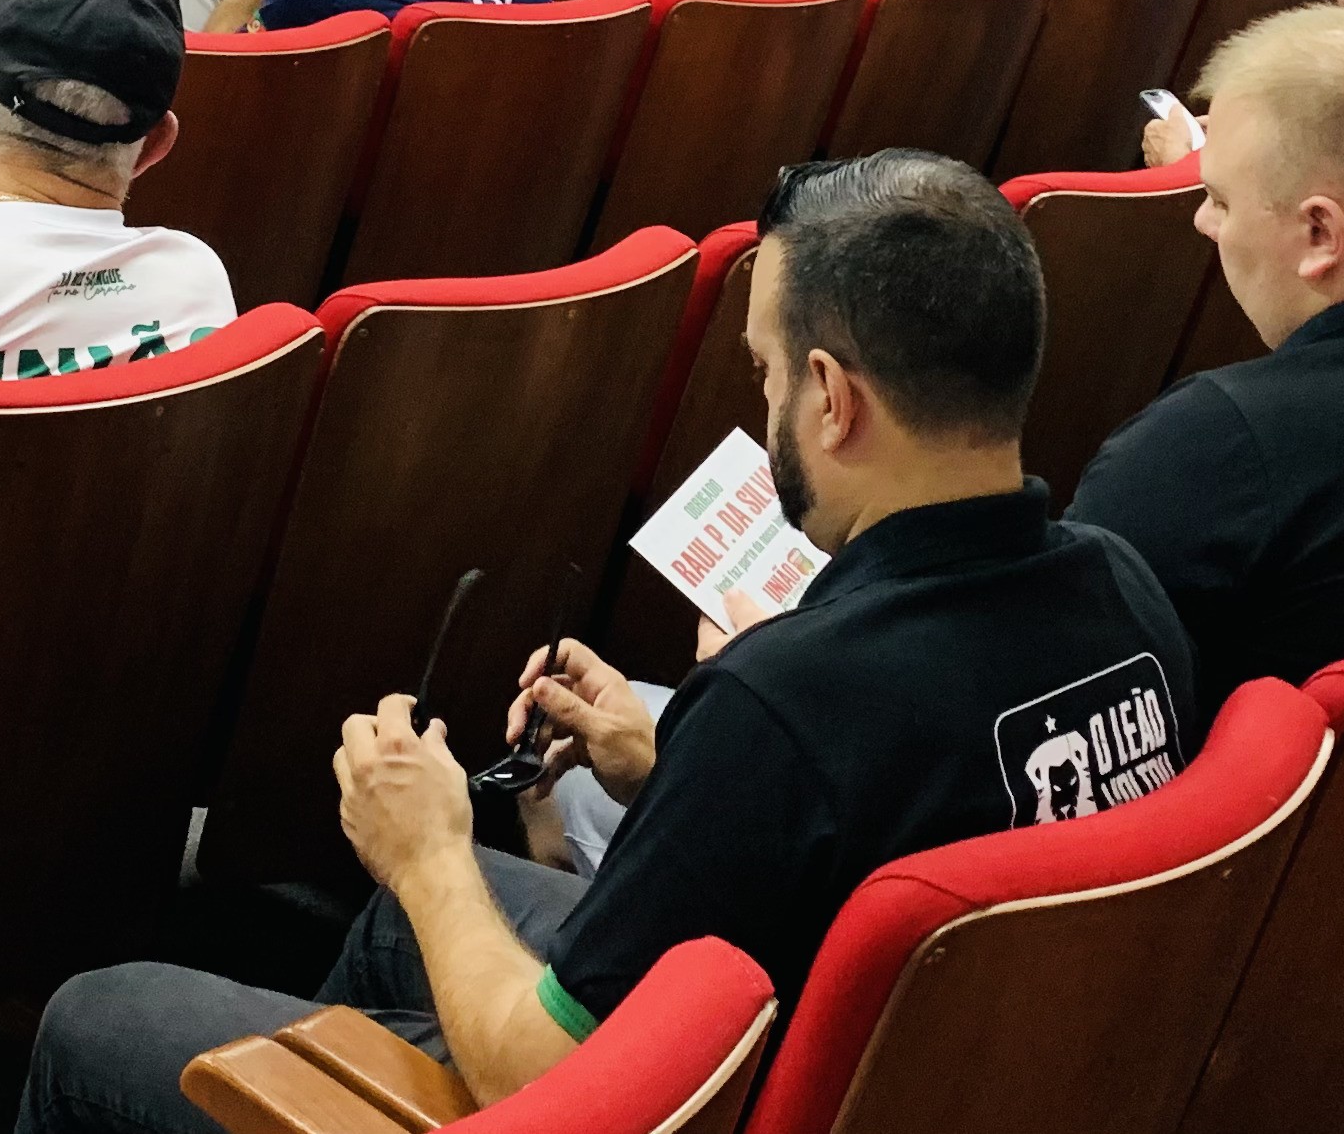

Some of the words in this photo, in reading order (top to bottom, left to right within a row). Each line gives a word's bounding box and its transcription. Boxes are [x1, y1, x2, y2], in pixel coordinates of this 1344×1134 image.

[84, 268, 123, 286] SANGUE
[684, 478, 724, 520] OBRIGADO
[735, 465, 778, 515] SILVA
[704, 523, 736, 552] P.
[716, 501, 754, 536] DA
[671, 537, 723, 588] RAUL
[727, 565, 744, 581] faz
[738, 547, 758, 572] parte
[762, 562, 801, 603] UNIÃO
[1089, 713, 1112, 775] O
[1109, 687, 1167, 766] LEÃO
